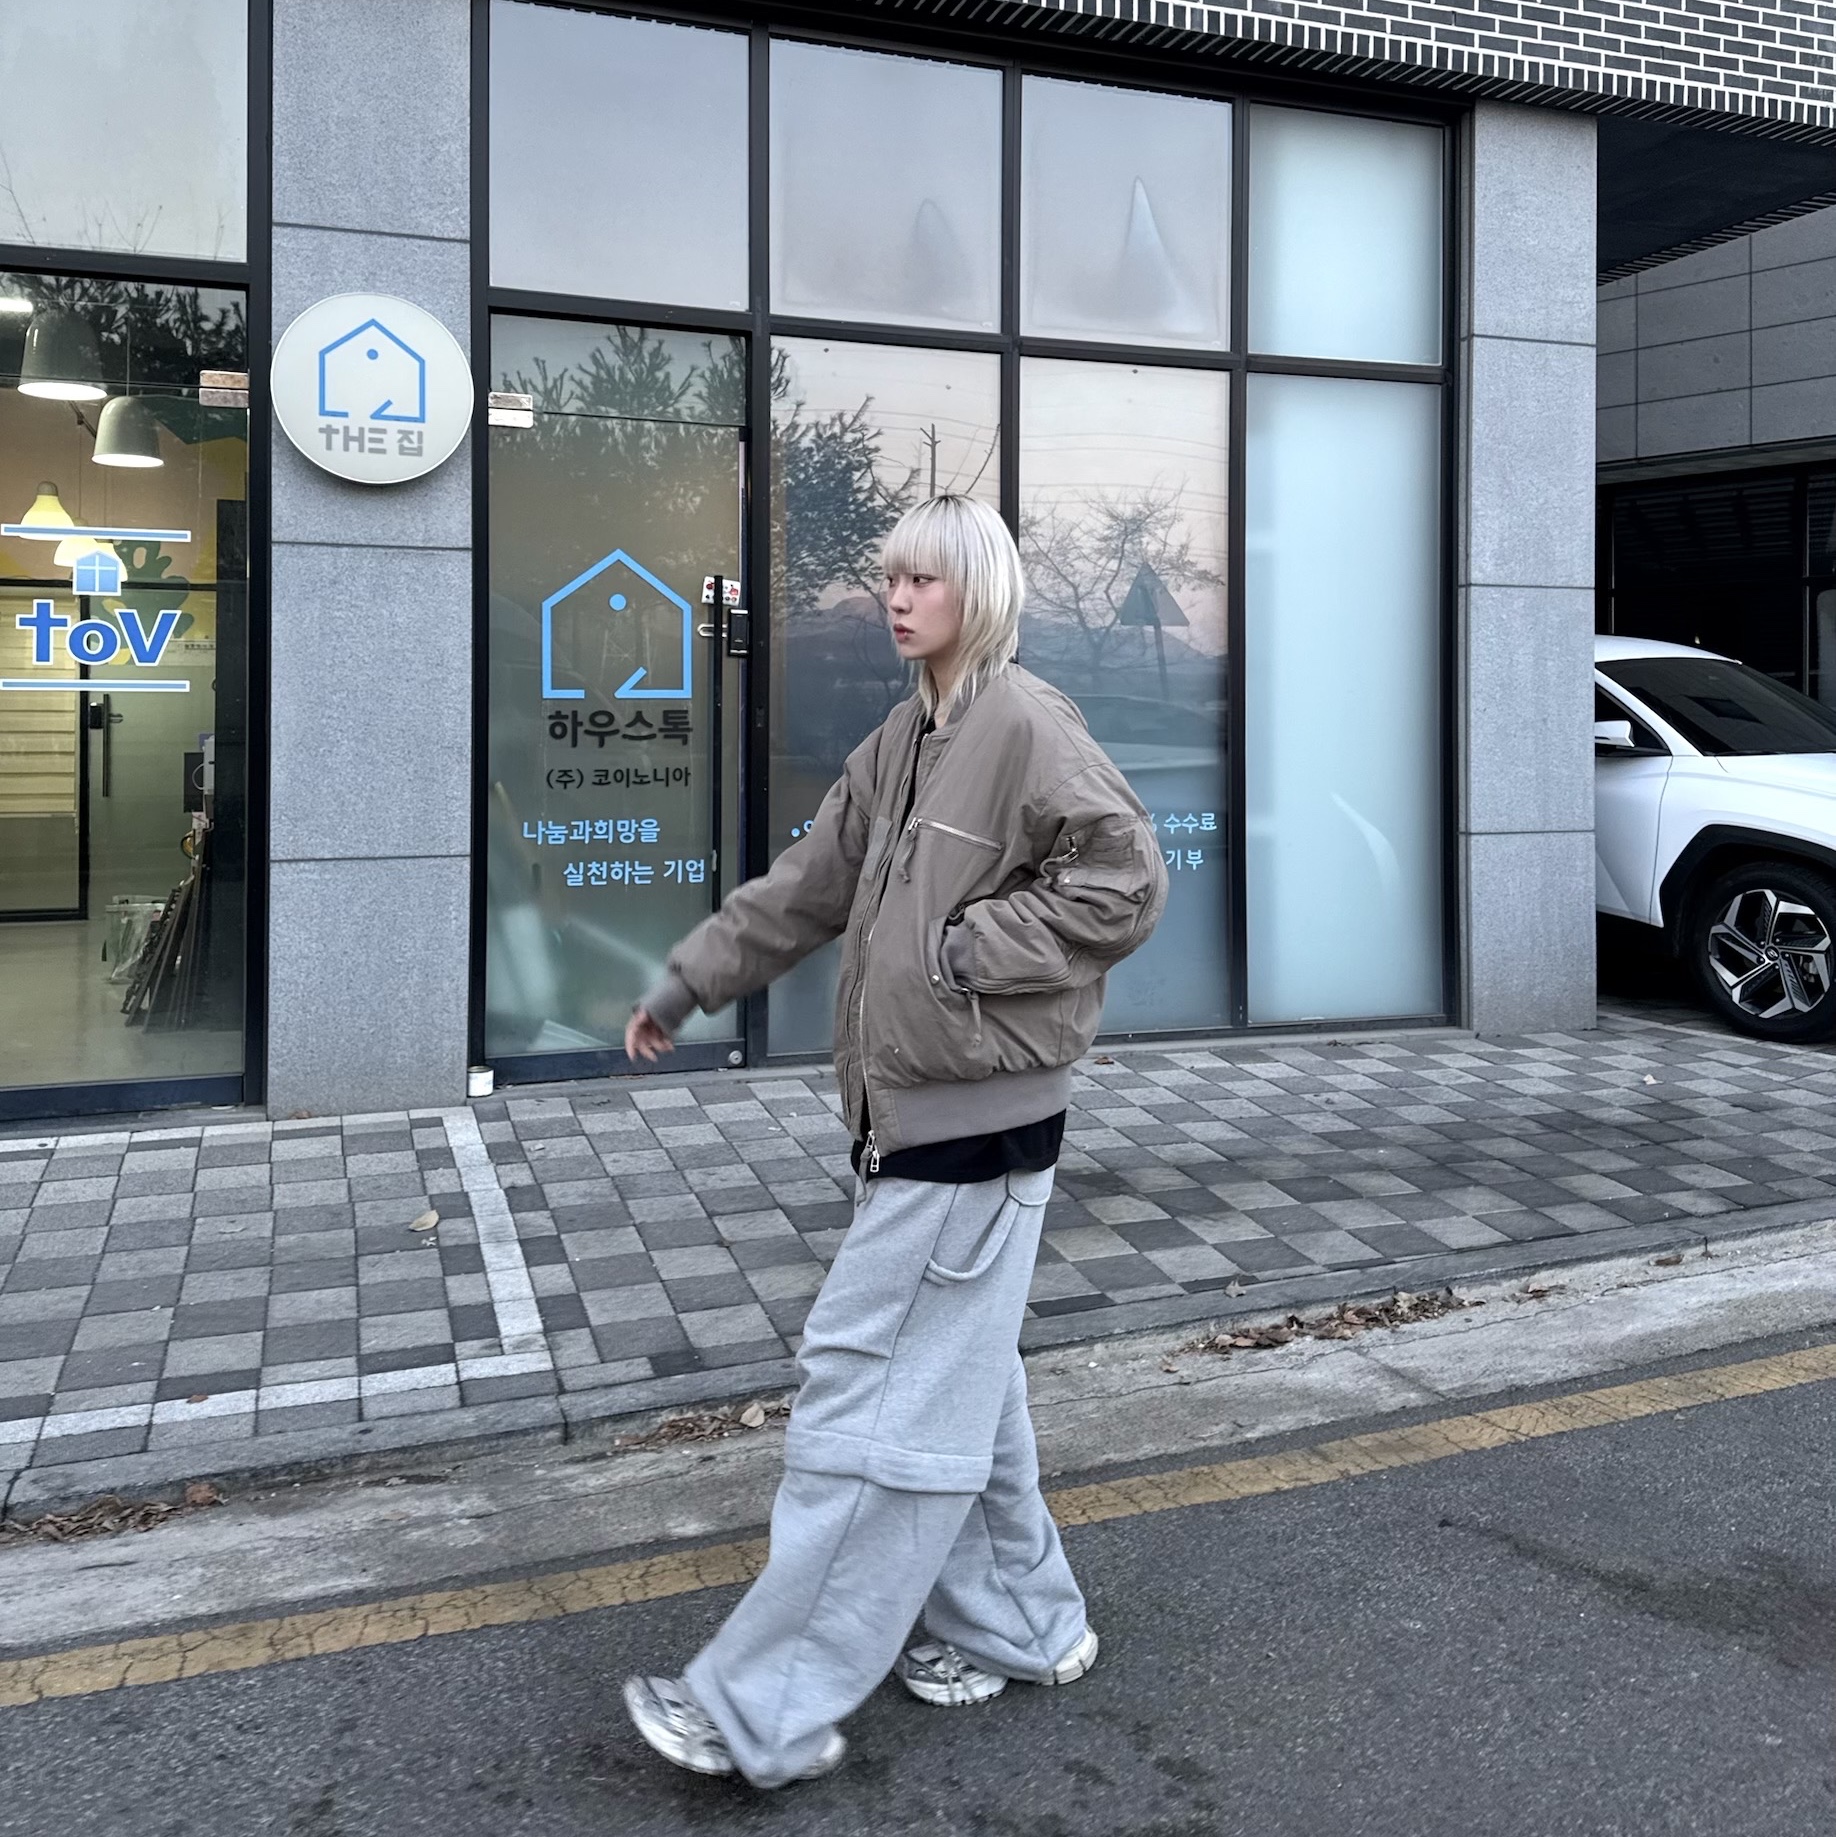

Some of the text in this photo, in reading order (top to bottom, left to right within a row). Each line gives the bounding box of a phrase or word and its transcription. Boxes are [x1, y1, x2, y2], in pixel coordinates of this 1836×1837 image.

[397, 429, 423, 457] 집
[548, 705, 693, 748] 하우스톡
[546, 766, 691, 790] (주) 코이노니아
[522, 818, 661, 845] 나눔과희망을
[1163, 813, 1217, 834] 수수료
[563, 859, 705, 887] 실천하는 기업
[1166, 849, 1204, 871] 기부
